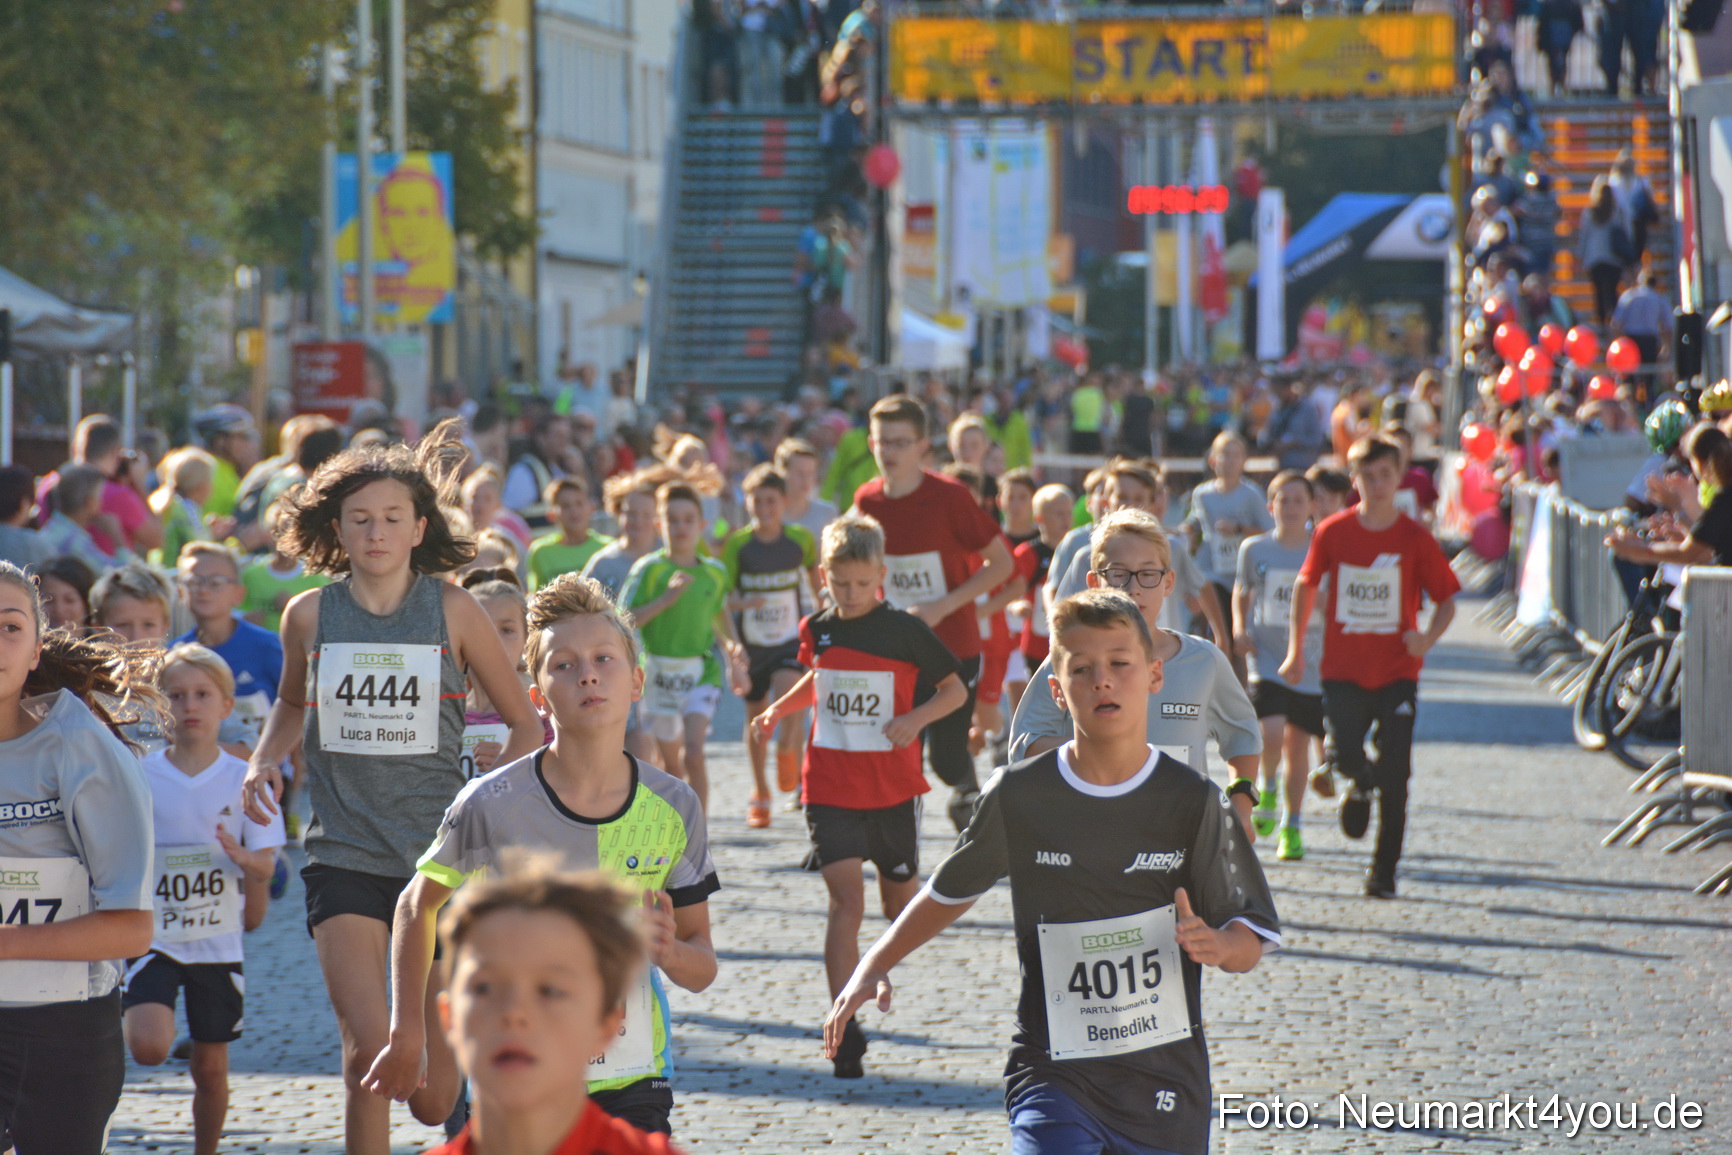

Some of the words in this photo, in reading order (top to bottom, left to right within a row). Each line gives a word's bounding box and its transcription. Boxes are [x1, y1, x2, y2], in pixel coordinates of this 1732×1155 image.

[1074, 37, 1266, 81] START
[890, 571, 932, 590] 4041
[1346, 583, 1391, 601] 4038
[353, 653, 405, 665] BOCK
[336, 674, 421, 707] 4444
[344, 711, 368, 719] PARTL
[369, 712, 404, 720] Neumarkt
[827, 692, 880, 717] 4042
[340, 726, 372, 740] Luca
[376, 727, 416, 744] Ronja
[0, 798, 64, 821] BOCK
[1035, 851, 1072, 866] JAKO
[1124, 852, 1175, 873] JURA
[156, 868, 225, 902] 4046
[0, 898, 62, 925] 47
[1081, 927, 1144, 949] BOCK
[1068, 948, 1162, 1000] 4015
[1080, 1006, 1110, 1015] PARTL
[1111, 998, 1148, 1013] Neumarkt
[1087, 1014, 1159, 1042] Benedikt
[1155, 1090, 1176, 1112] 15
